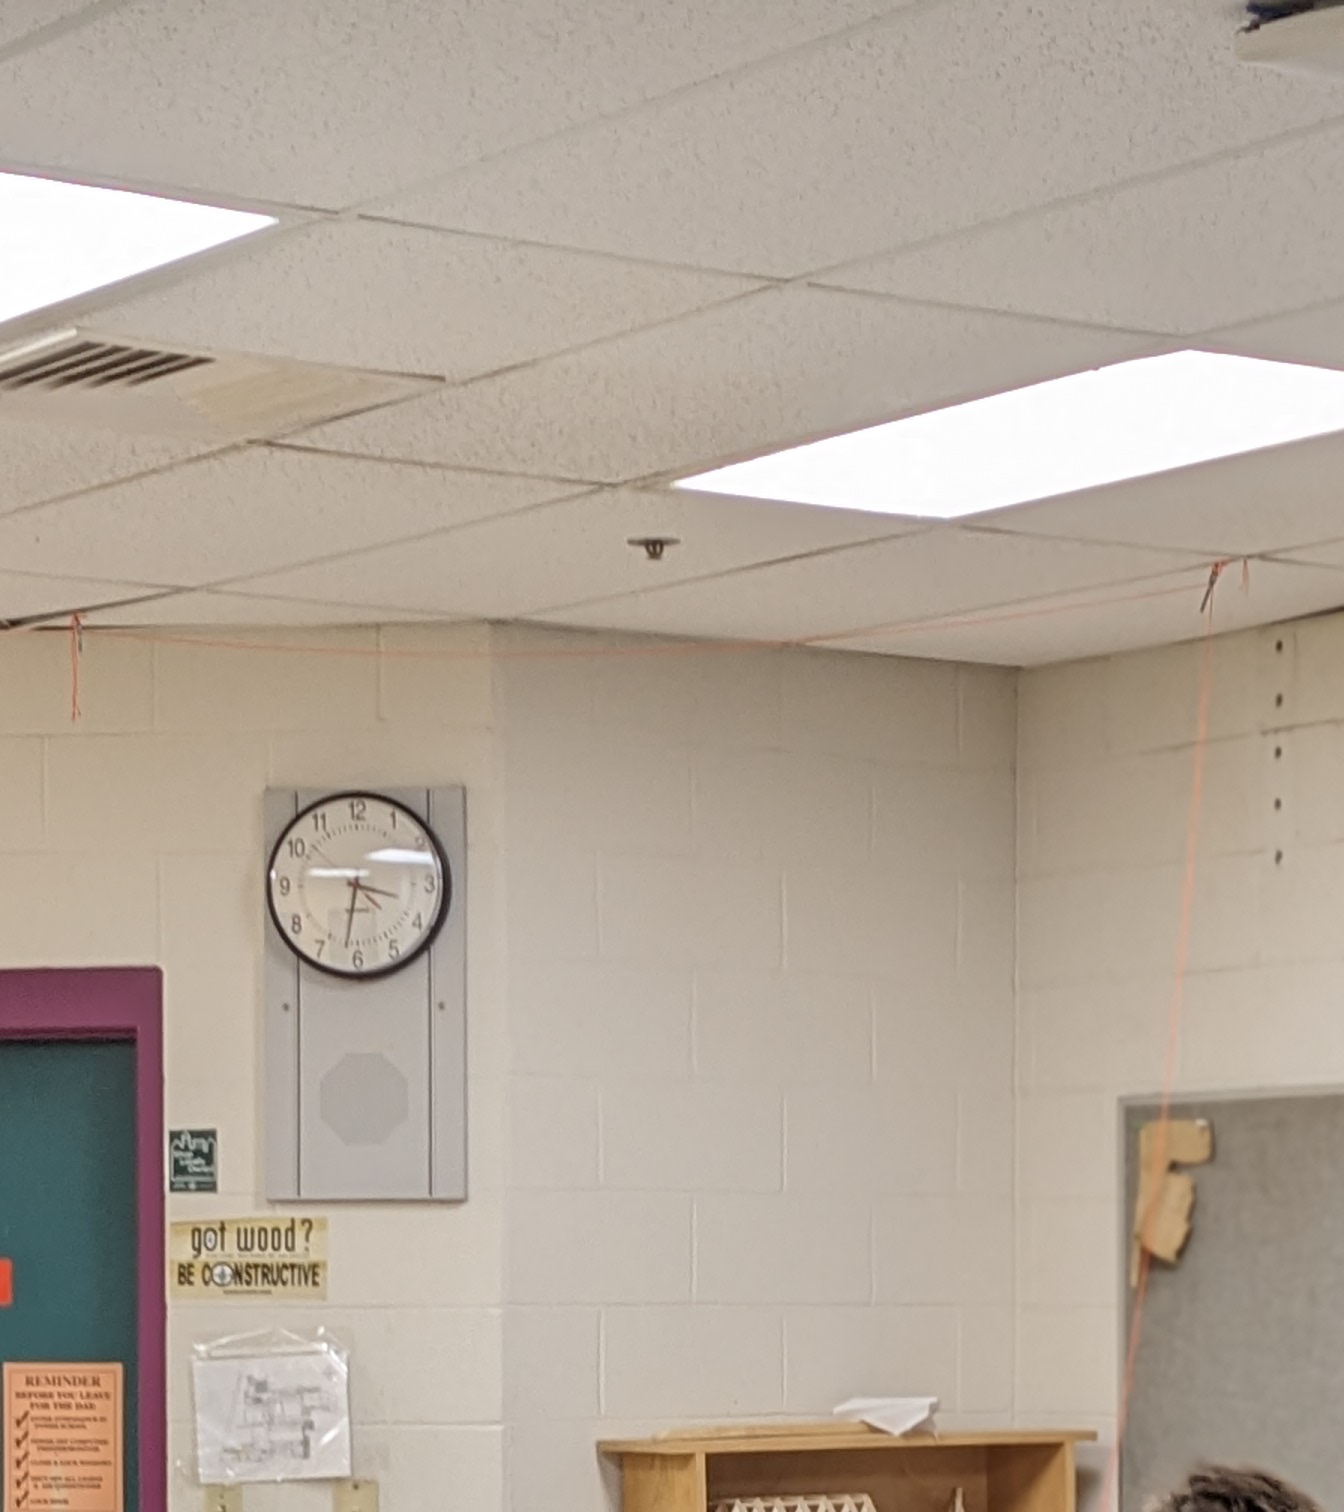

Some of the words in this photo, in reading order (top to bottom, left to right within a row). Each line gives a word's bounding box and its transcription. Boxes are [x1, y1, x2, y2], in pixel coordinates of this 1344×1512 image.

[349, 801, 366, 821] 12
[390, 809, 397, 830] 1
[312, 812, 326, 832] 11
[288, 837, 305, 858] 10
[280, 877, 290, 895] 9
[424, 875, 435, 894] 3
[291, 914, 302, 934] 8
[412, 912, 422, 931] 4
[314, 940, 324, 959] 7
[388, 939, 399, 961] 5
[352, 950, 363, 969] 6
[191, 1220, 226, 1259] got
[177, 1262, 195, 1287] BE
[201, 1261, 320, 1288] CONSTRUCTIVE
[25, 1375, 101, 1387] REMINDER
[16, 1391, 54, 1400] BEFORE
[57, 1391, 75, 1400] YOU
[79, 1391, 111, 1400] LEAVE
[30, 1402, 50, 1410] FOR
[53, 1402, 72, 1410] THE
